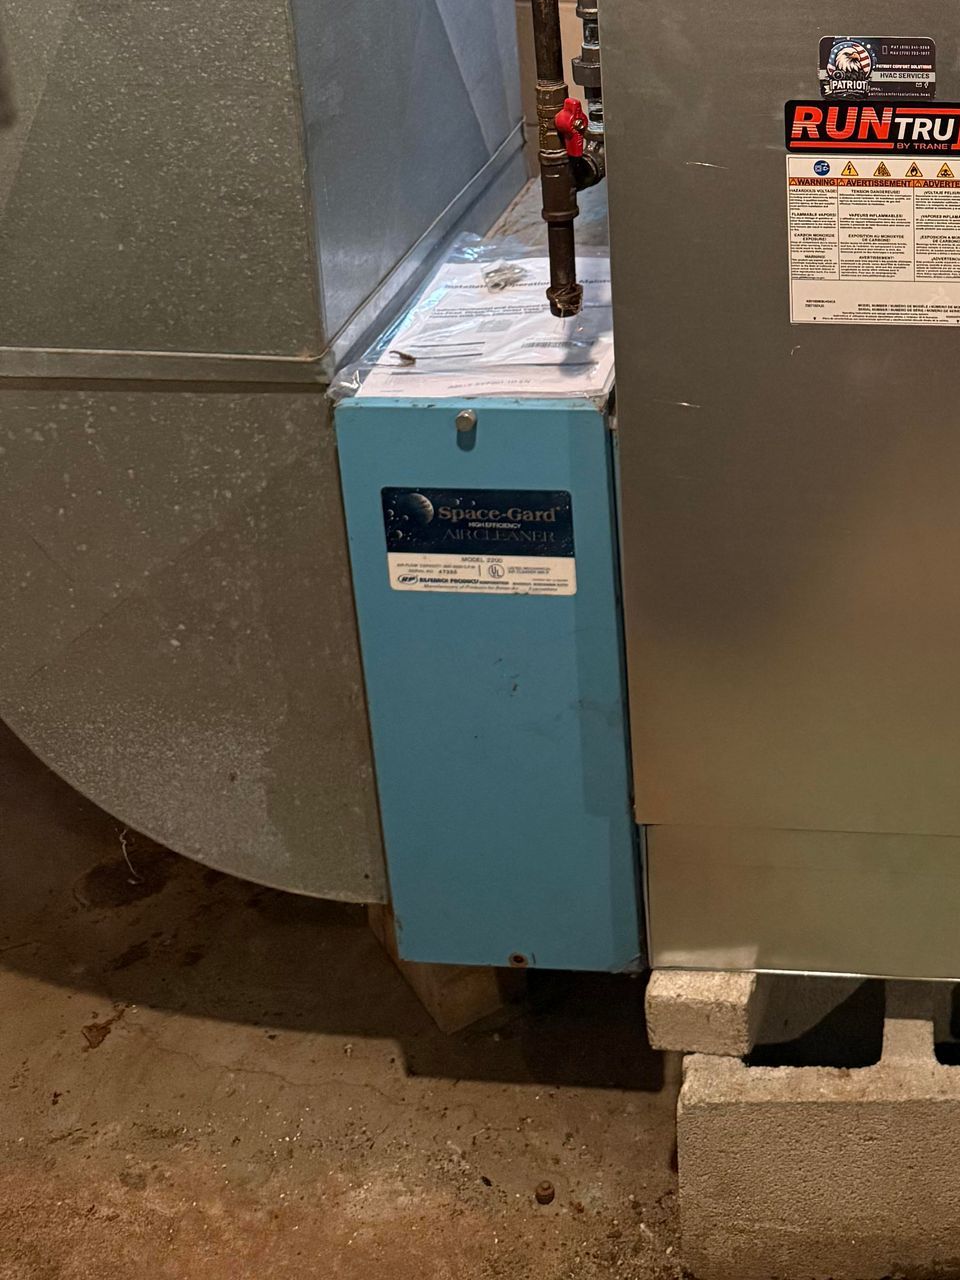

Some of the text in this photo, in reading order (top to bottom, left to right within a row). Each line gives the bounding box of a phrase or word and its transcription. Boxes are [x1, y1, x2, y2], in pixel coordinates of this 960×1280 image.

[832, 80, 867, 90] PATRIOT
[797, 178, 836, 186] WARNING
[846, 179, 912, 187] AVERTISSEMENT
[438, 506, 556, 522] Space-Gard
[443, 528, 554, 542] AIR CLEANER
